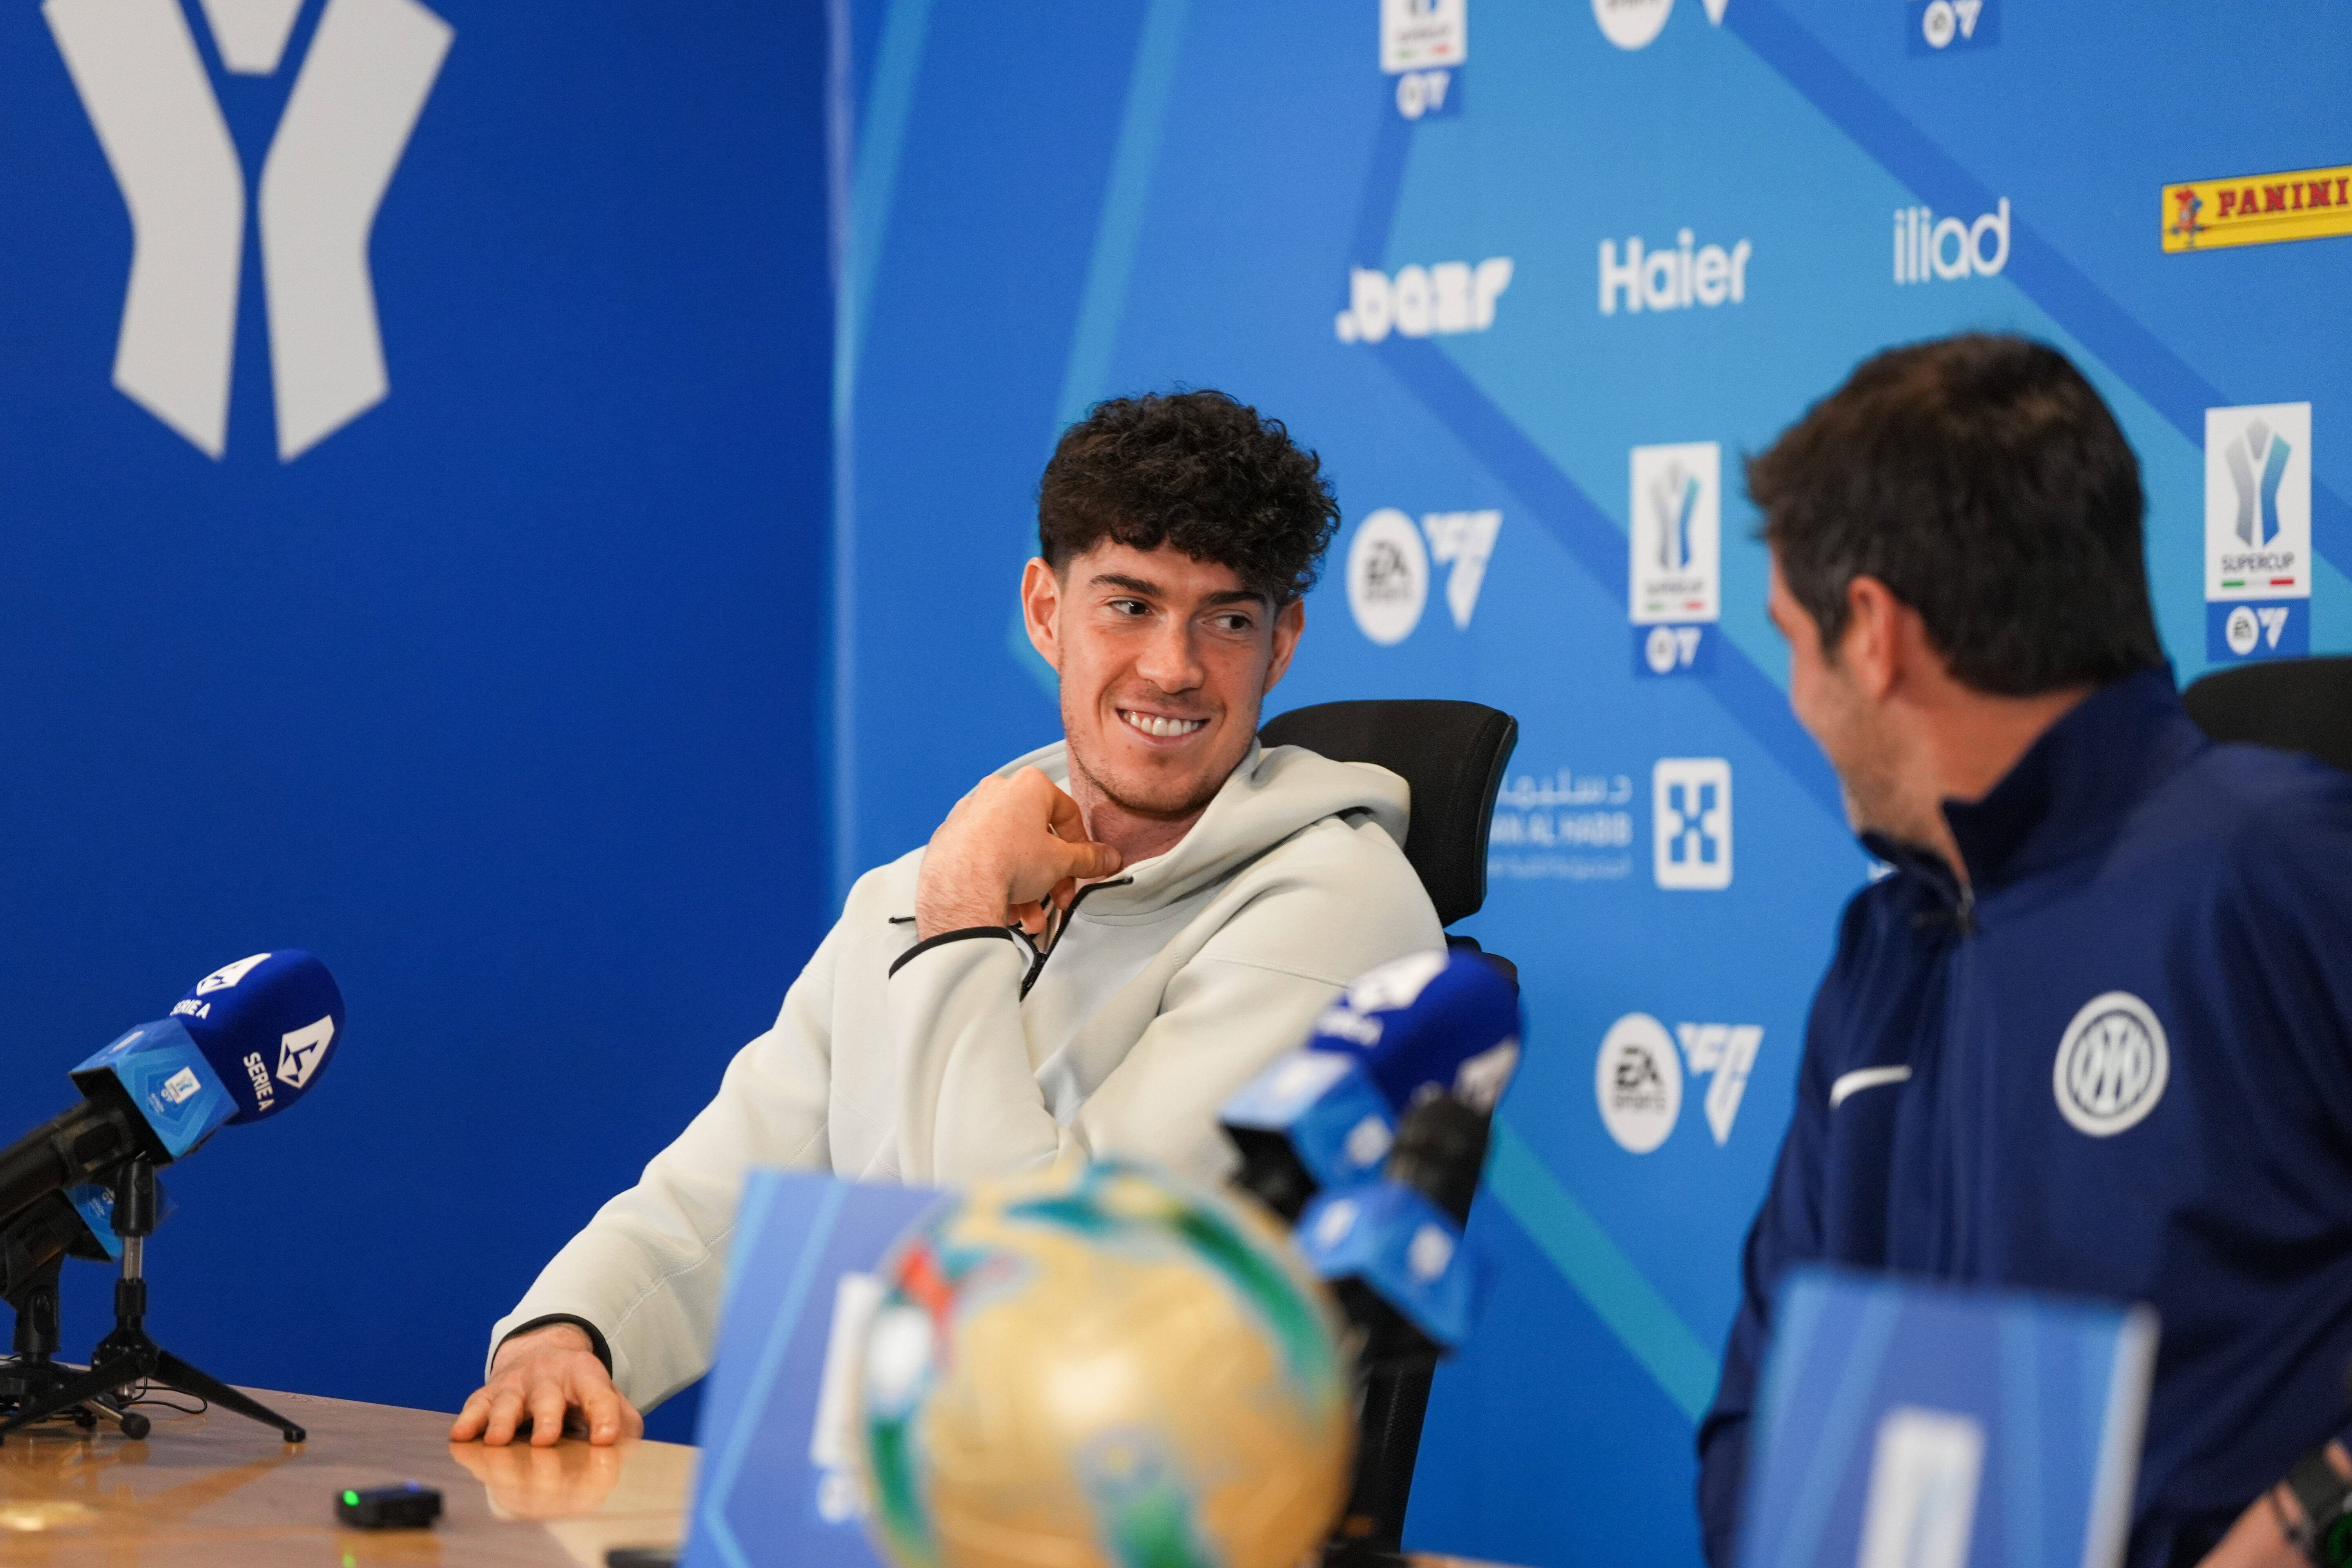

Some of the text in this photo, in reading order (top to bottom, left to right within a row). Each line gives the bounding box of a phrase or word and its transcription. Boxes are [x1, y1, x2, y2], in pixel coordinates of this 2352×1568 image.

[2218, 177, 2349, 218] PANINI
[1894, 197, 2010, 284] iliad
[1599, 227, 1752, 315] Haier
[2220, 550, 2296, 575] SUPERCUP
[195, 1002, 211, 1020] A
[243, 1051, 275, 1112] SERIE A
